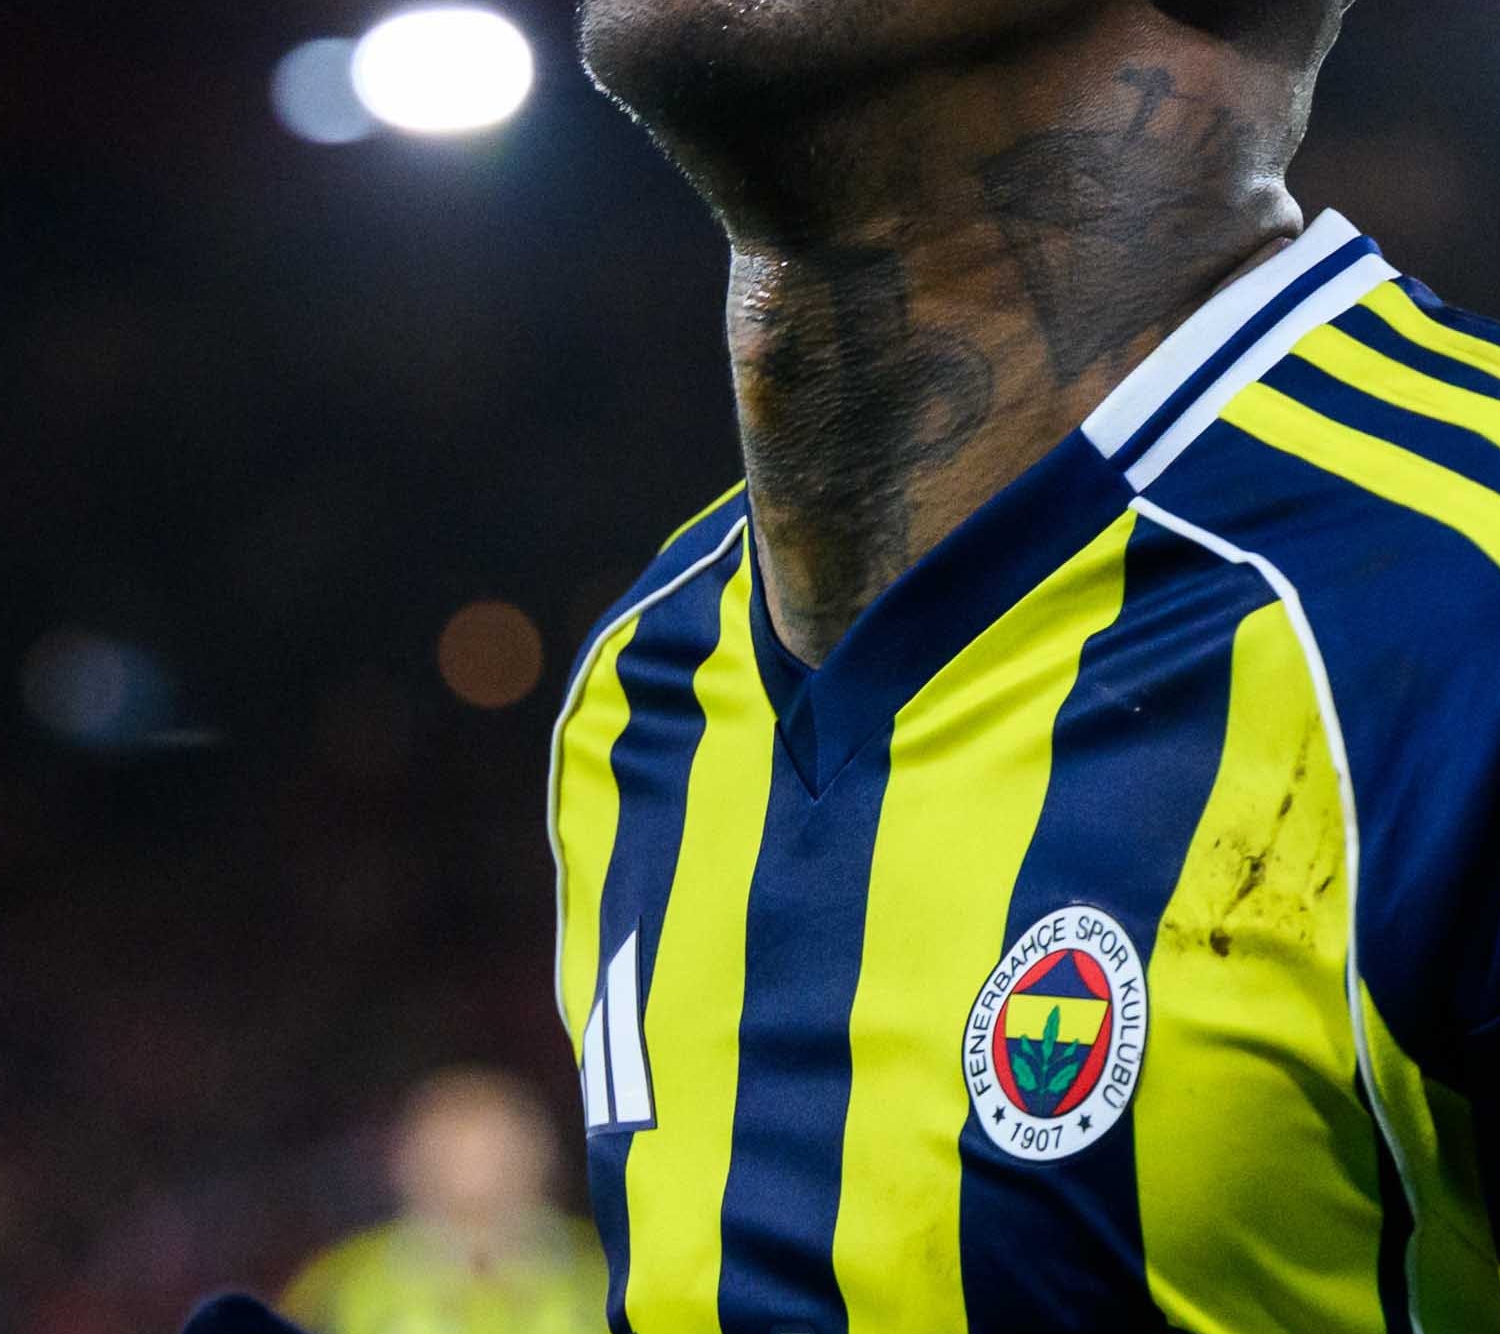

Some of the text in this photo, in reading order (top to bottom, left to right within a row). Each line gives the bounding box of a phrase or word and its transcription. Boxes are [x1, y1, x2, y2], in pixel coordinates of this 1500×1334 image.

[969, 917, 1066, 1097] FENERBAHÇE
[1075, 916, 1129, 973] SPOR
[1010, 1122, 1064, 1152] 1907
